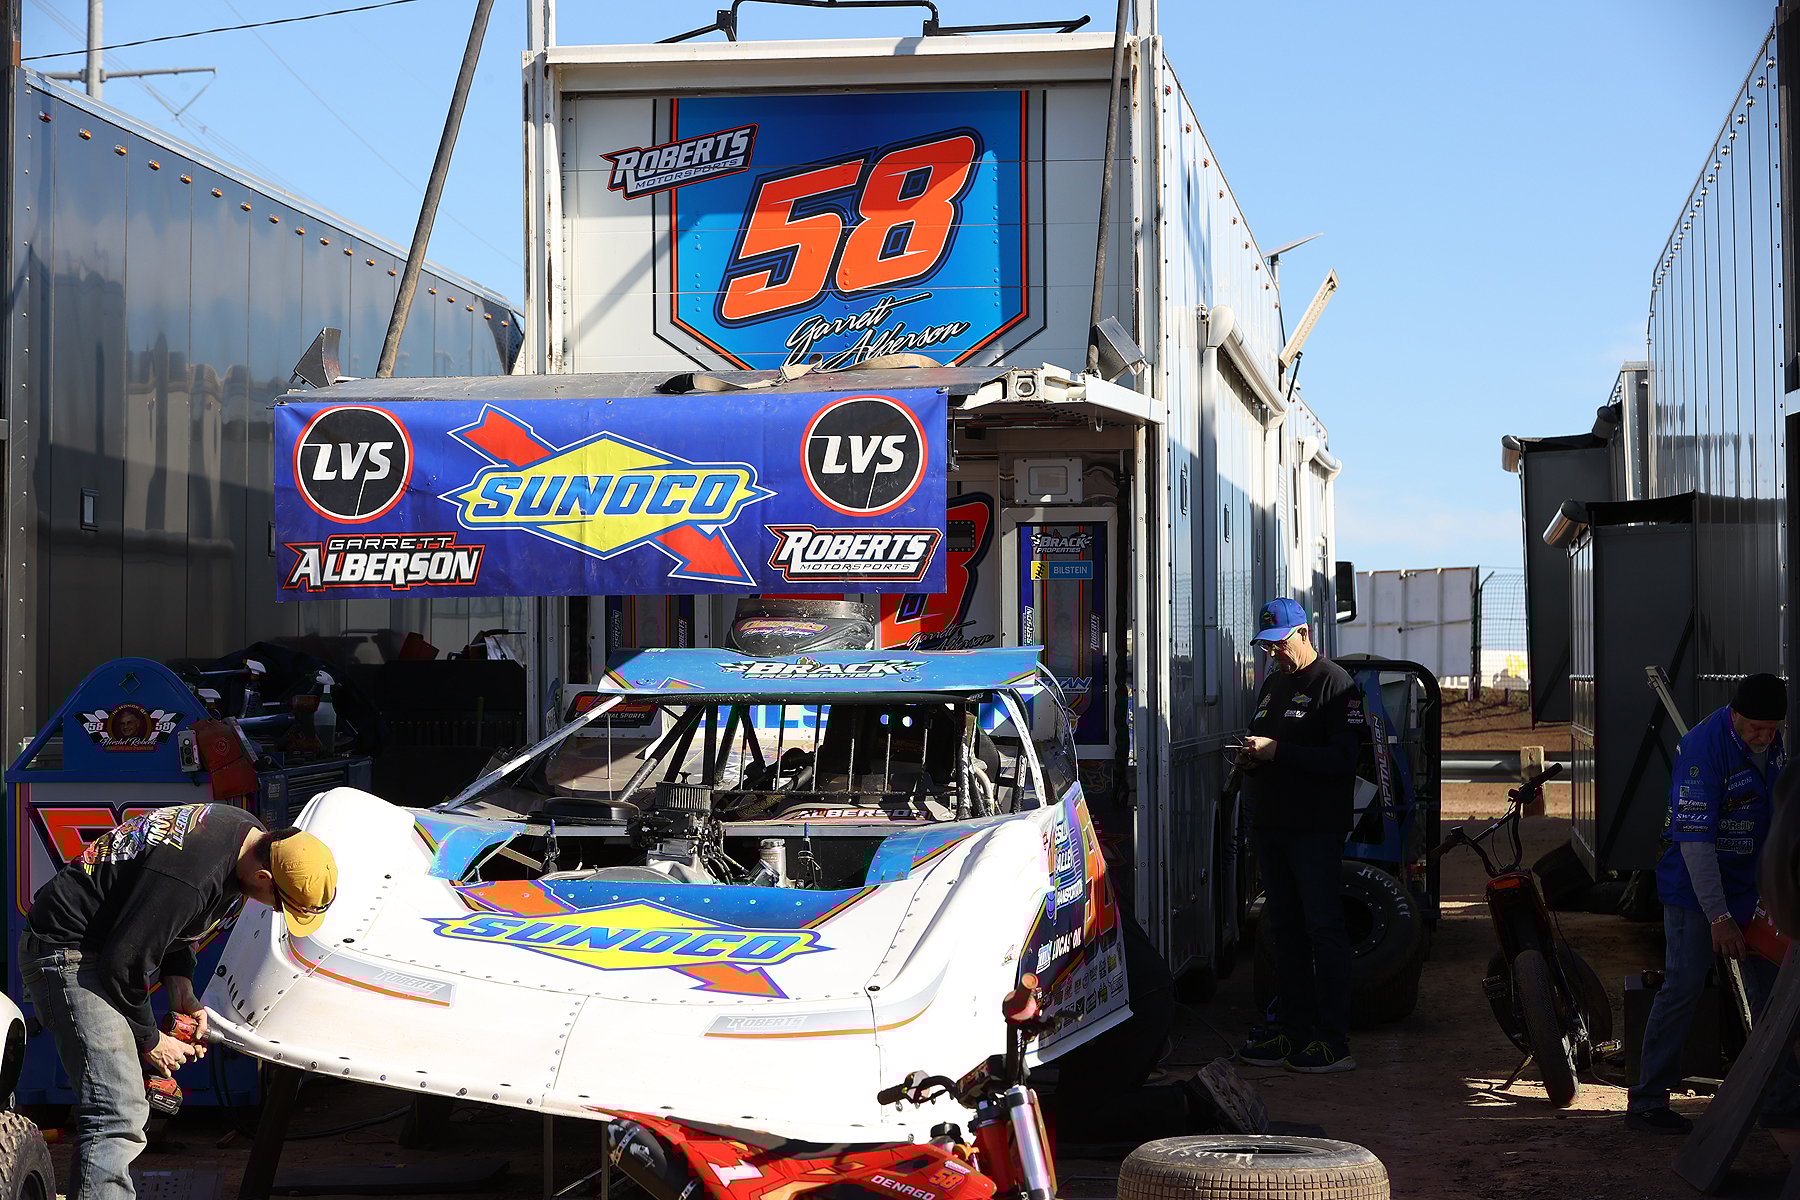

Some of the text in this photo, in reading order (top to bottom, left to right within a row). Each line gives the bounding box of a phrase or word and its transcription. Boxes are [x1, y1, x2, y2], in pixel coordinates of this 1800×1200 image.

[613, 128, 752, 193] ROBERTS
[635, 158, 739, 190] MOTORSPORTS
[719, 134, 978, 321] 58
[786, 293, 931, 366] Garrett
[821, 322, 970, 369] Alberson
[310, 441, 394, 481] LVS
[818, 435, 907, 474] LVS
[471, 474, 740, 517] SUNOCO
[328, 538, 453, 550] GARRETT
[777, 531, 933, 564] ROBERTS
[1040, 535, 1086, 548] BRACK
[291, 548, 479, 586] ALBERSON
[799, 563, 911, 571] MOTORSPORTS
[1053, 566, 1088, 575] BILSTEIN
[746, 663, 902, 675] BRACK
[88, 722, 105, 731] 58
[155, 721, 171, 731] 58
[1719, 819, 1755, 832] O'Reilly
[454, 917, 802, 960] SUNOCO
[1052, 932, 1073, 960] LUCAS
[1073, 926, 1082, 949] OIL
[376, 970, 443, 992] ROBERTS
[729, 1016, 804, 1028] ROBERTS
[870, 1174, 936, 1200] DENAGO
[929, 1170, 965, 1190] 58
